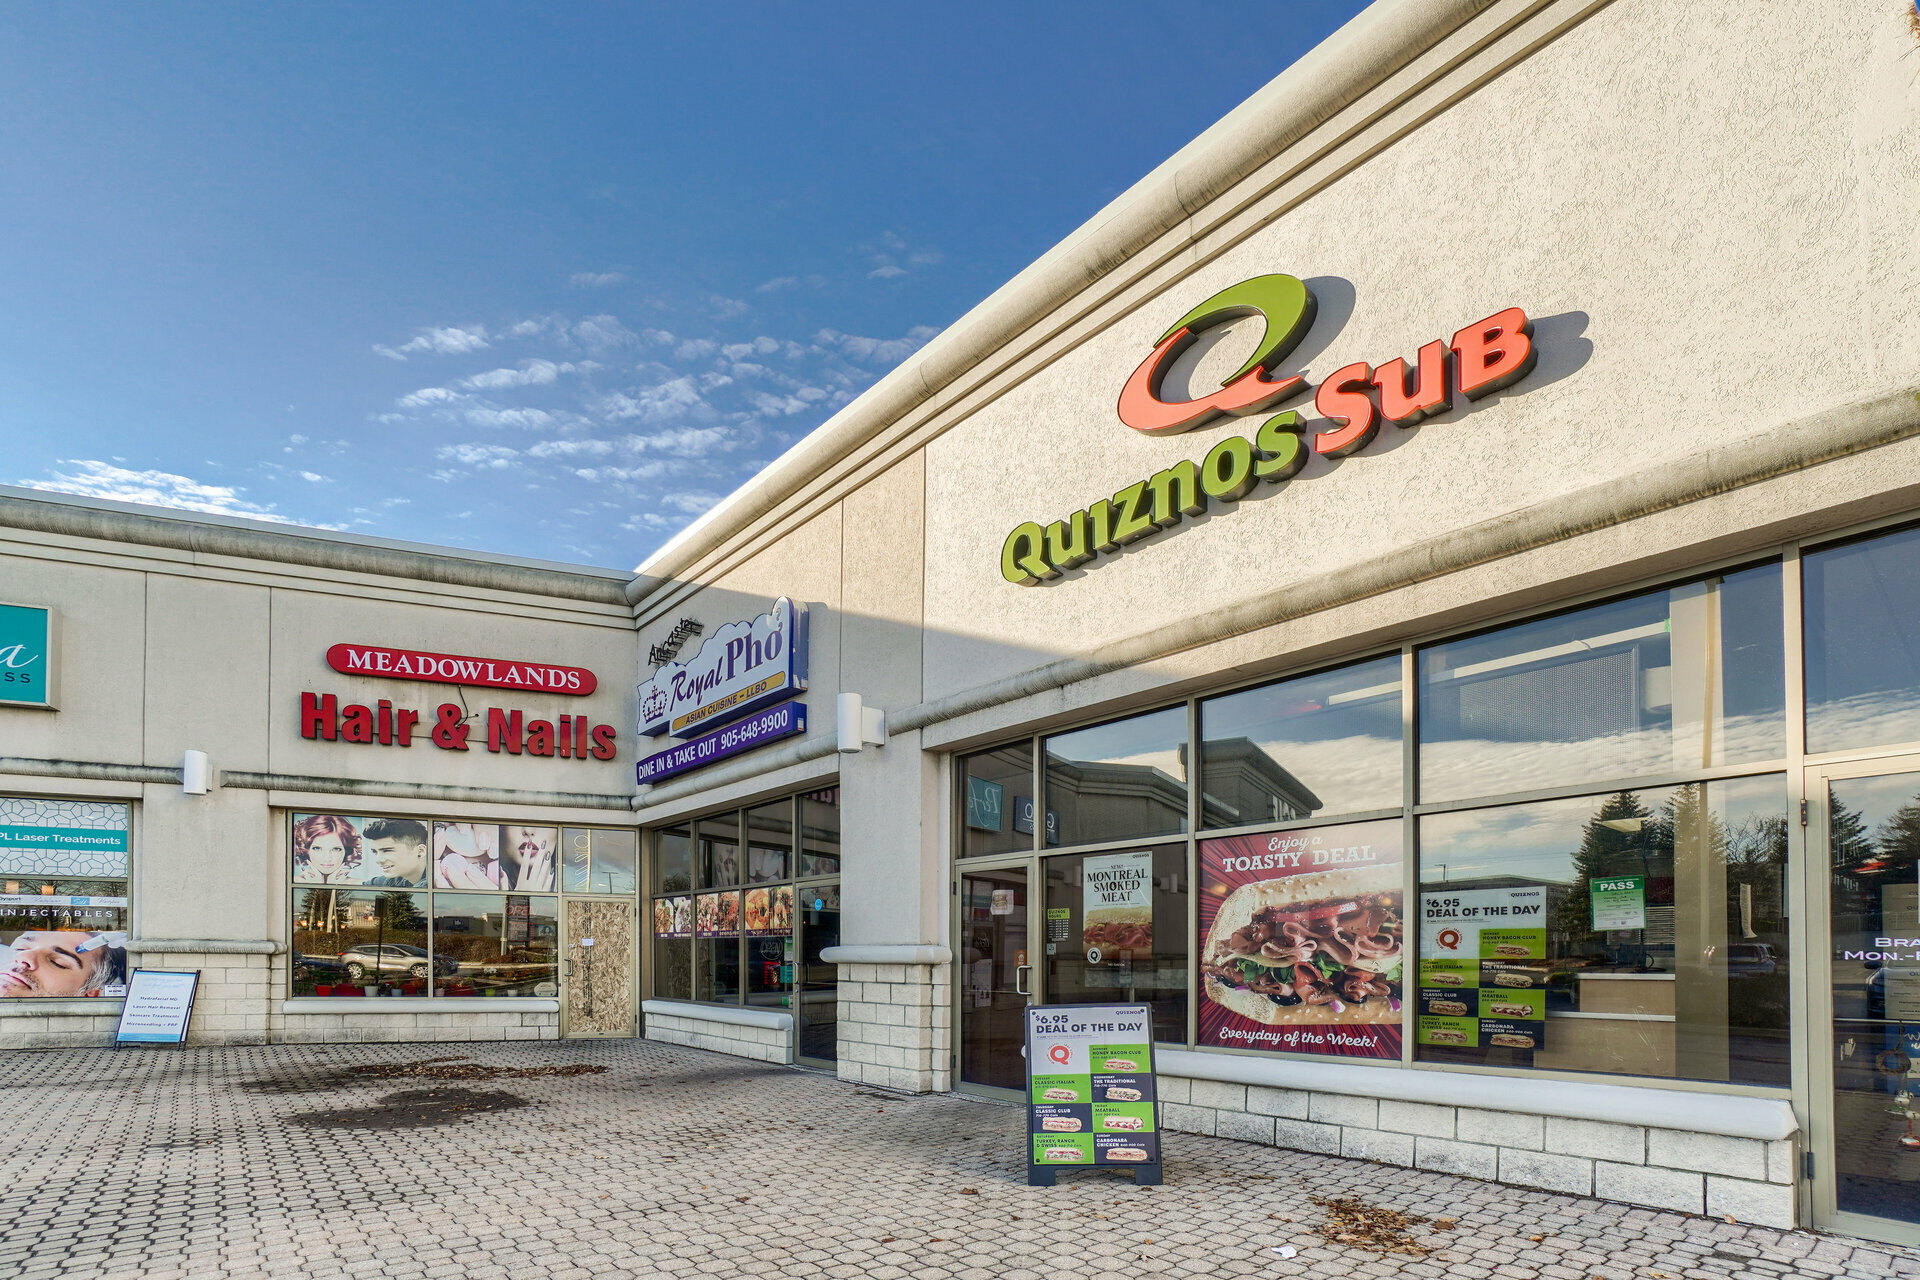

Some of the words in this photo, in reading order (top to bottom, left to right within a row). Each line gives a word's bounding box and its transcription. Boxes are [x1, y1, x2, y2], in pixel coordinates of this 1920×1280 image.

[347, 649, 581, 690] MEADOWLANDS
[670, 656, 724, 712] Royal
[685, 710, 706, 725] ASIAN
[708, 697, 737, 718] CUISINE
[746, 681, 767, 701] LLBO
[301, 692, 419, 747] Hair
[432, 703, 470, 751] &
[487, 707, 617, 760] Nails
[638, 761, 656, 780] DINE
[656, 758, 665, 772] IN
[666, 754, 674, 769] &
[674, 746, 696, 766] TAKE
[698, 738, 716, 758] OUT
[721, 710, 788, 750] 905-648-9900
[16, 832, 50, 842] Laser
[52, 834, 121, 845] Treatments
[1268, 836, 1308, 852] Enjoy
[1311, 836, 1323, 846] a
[1222, 852, 1300, 872] TOASTY
[1312, 845, 1377, 866] DEAL
[1087, 868, 1148, 883] MONTREAL
[1094, 880, 1140, 892] SMOKED
[1600, 881, 1635, 891] PASS
[1101, 891, 1132, 903] MEAT
[1426, 898, 1460, 908] $6.95
[0, 908, 114, 918] INJECTABLES
[1427, 908, 1458, 918] DEAL
[1462, 907, 1480, 917] OF
[1482, 906, 1508, 916] THE
[1512, 905, 1541, 915] DAY
[1440, 930, 1459, 950] Q
[1036, 1015, 1068, 1024] $6.95
[1036, 1024, 1068, 1033] DEAL
[1071, 1024, 1087, 1032] OF
[1091, 1023, 1114, 1032] THE
[1118, 1023, 1143, 1031] DAY
[1219, 1026, 1282, 1045] Everyday
[1283, 1032, 1299, 1045] of
[1300, 1032, 1324, 1044] the
[1326, 1033, 1378, 1048] Week!
[1050, 1045, 1069, 1065] Q
